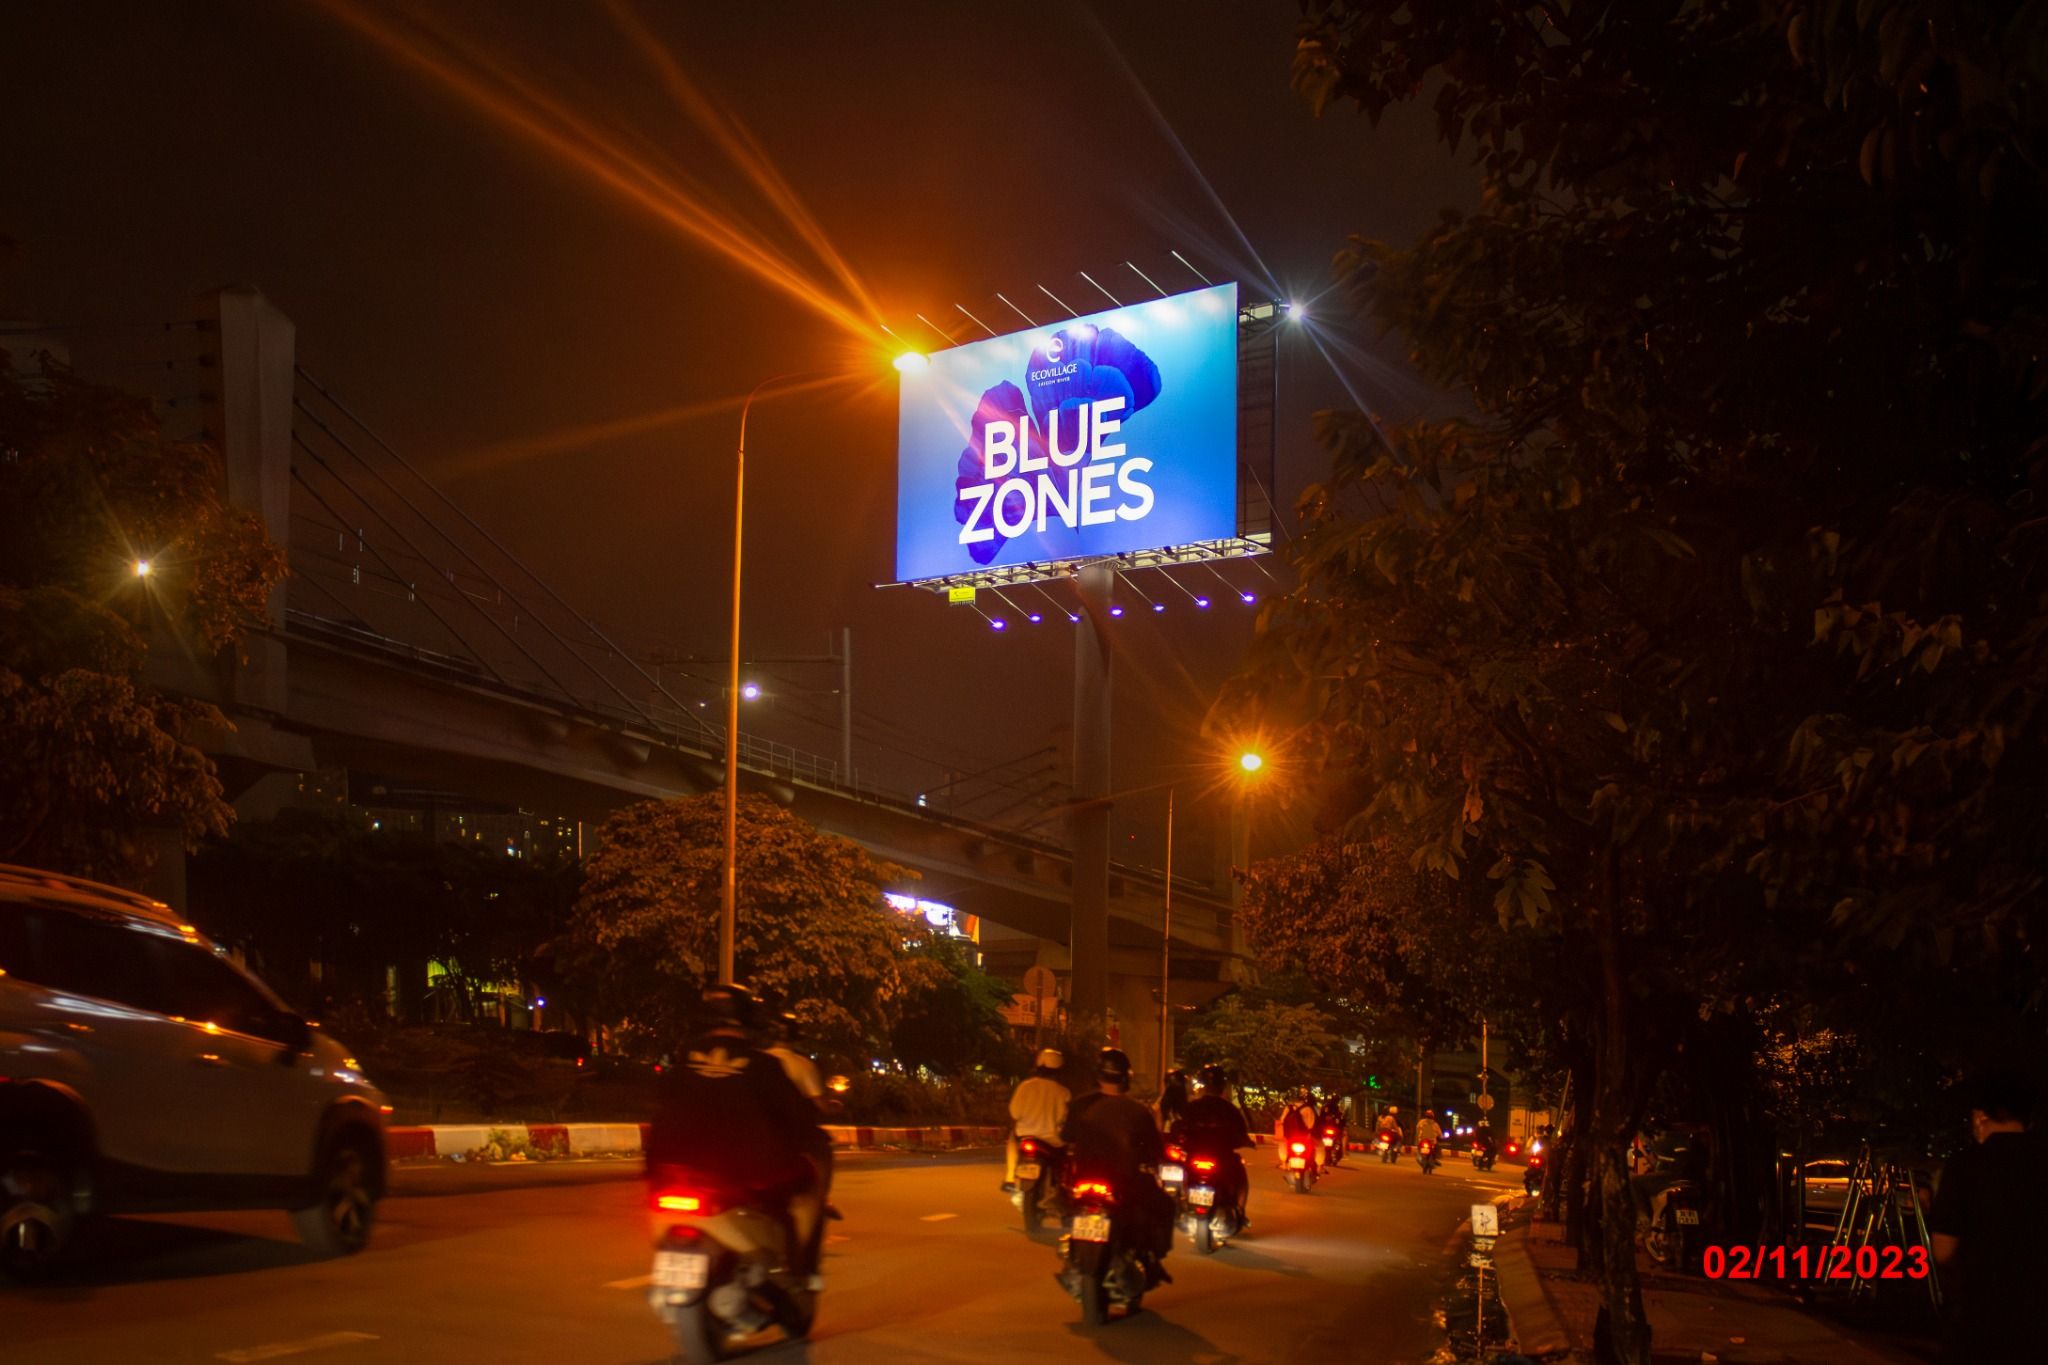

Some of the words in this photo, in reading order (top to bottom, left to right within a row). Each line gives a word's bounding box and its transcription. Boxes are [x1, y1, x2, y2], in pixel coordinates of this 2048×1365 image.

[1031, 363, 1078, 382] ECOVILLAGE
[984, 396, 1126, 480] BLUE
[958, 457, 1156, 545] ZONES
